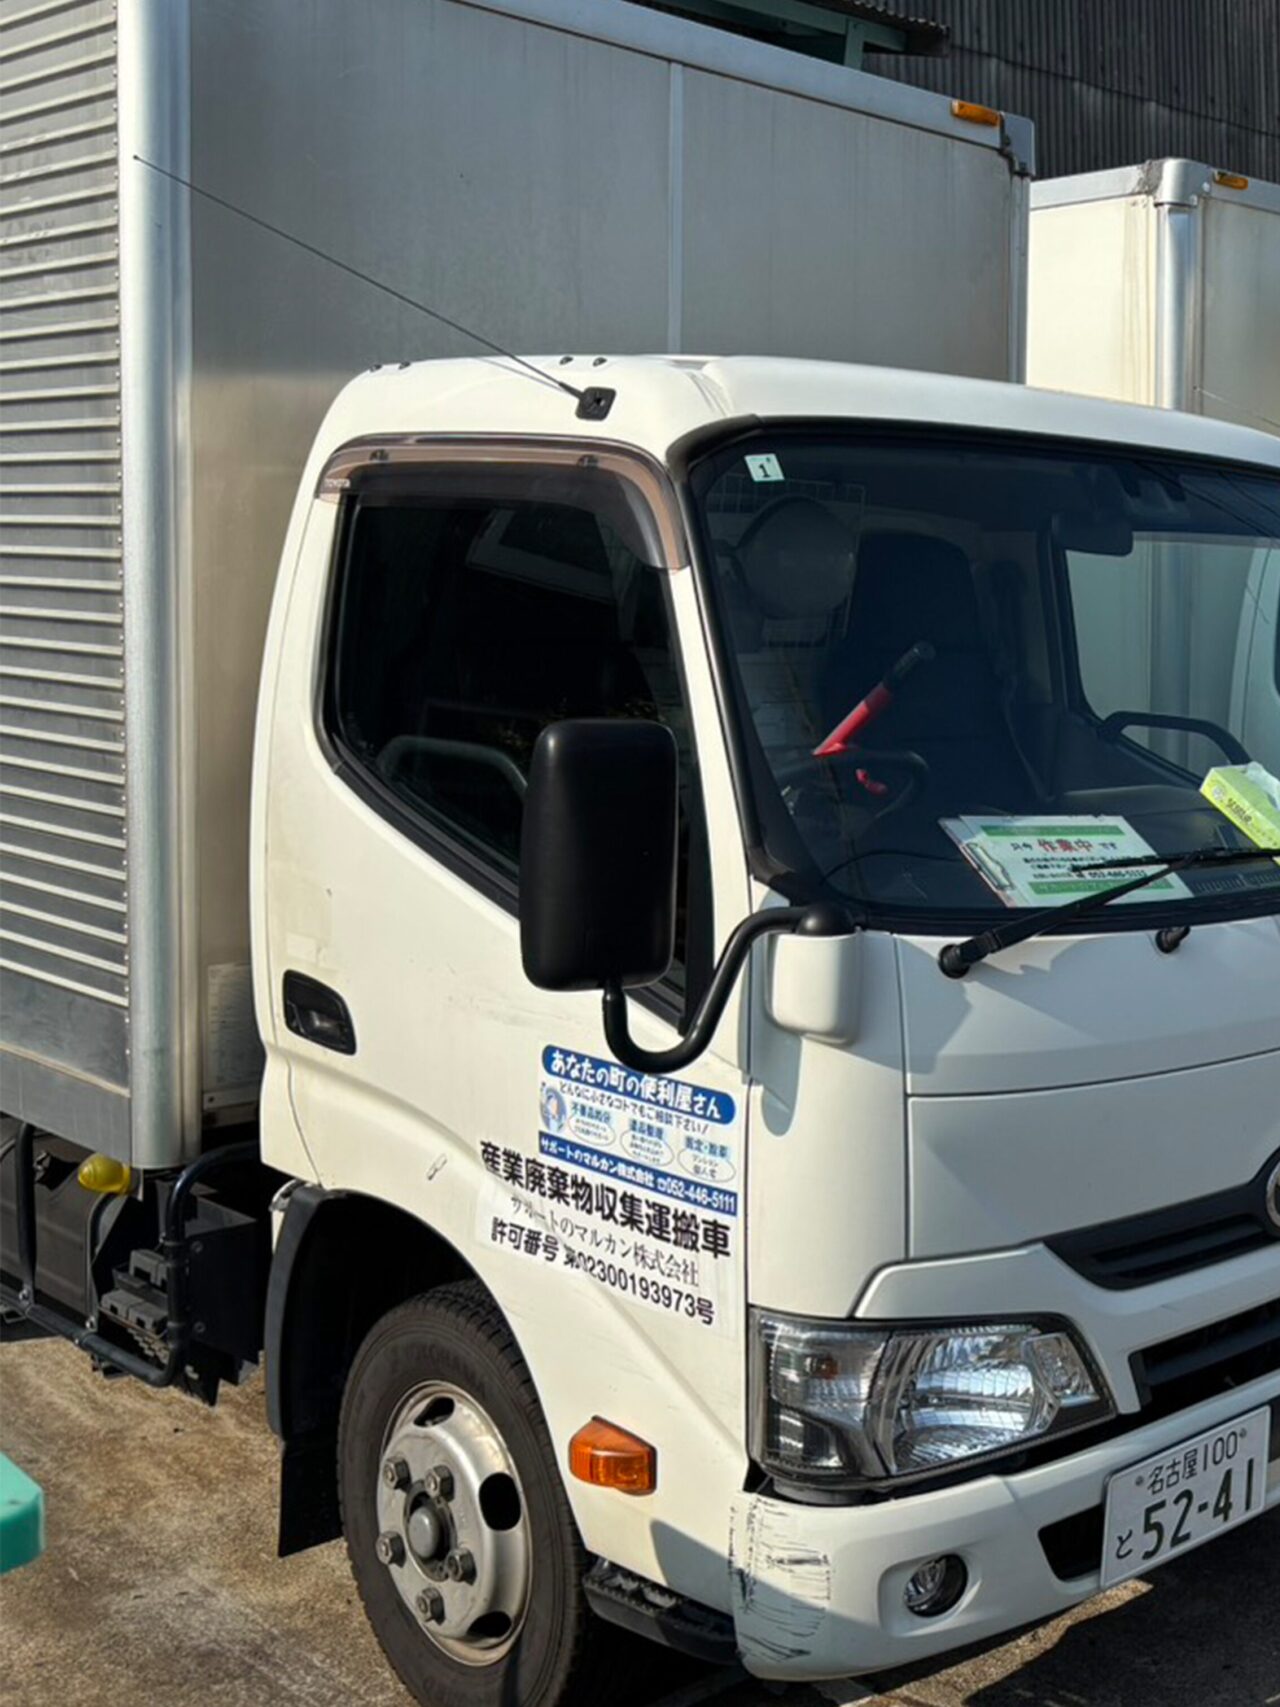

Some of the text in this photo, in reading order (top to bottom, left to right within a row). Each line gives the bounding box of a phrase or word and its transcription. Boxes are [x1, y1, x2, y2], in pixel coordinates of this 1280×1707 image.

[759, 464, 770, 478] 1
[552, 1049, 721, 1119] あなたの町の便利屋さん
[541, 1137, 655, 1187] サポートのマルカン株式会社
[480, 1140, 732, 1260] 産業廃棄物収集運搬車
[492, 1216, 560, 1263] 許可番号
[511, 1196, 700, 1288] サポートのマルカン株式会社
[1115, 1458, 1254, 1561] と 52-41
